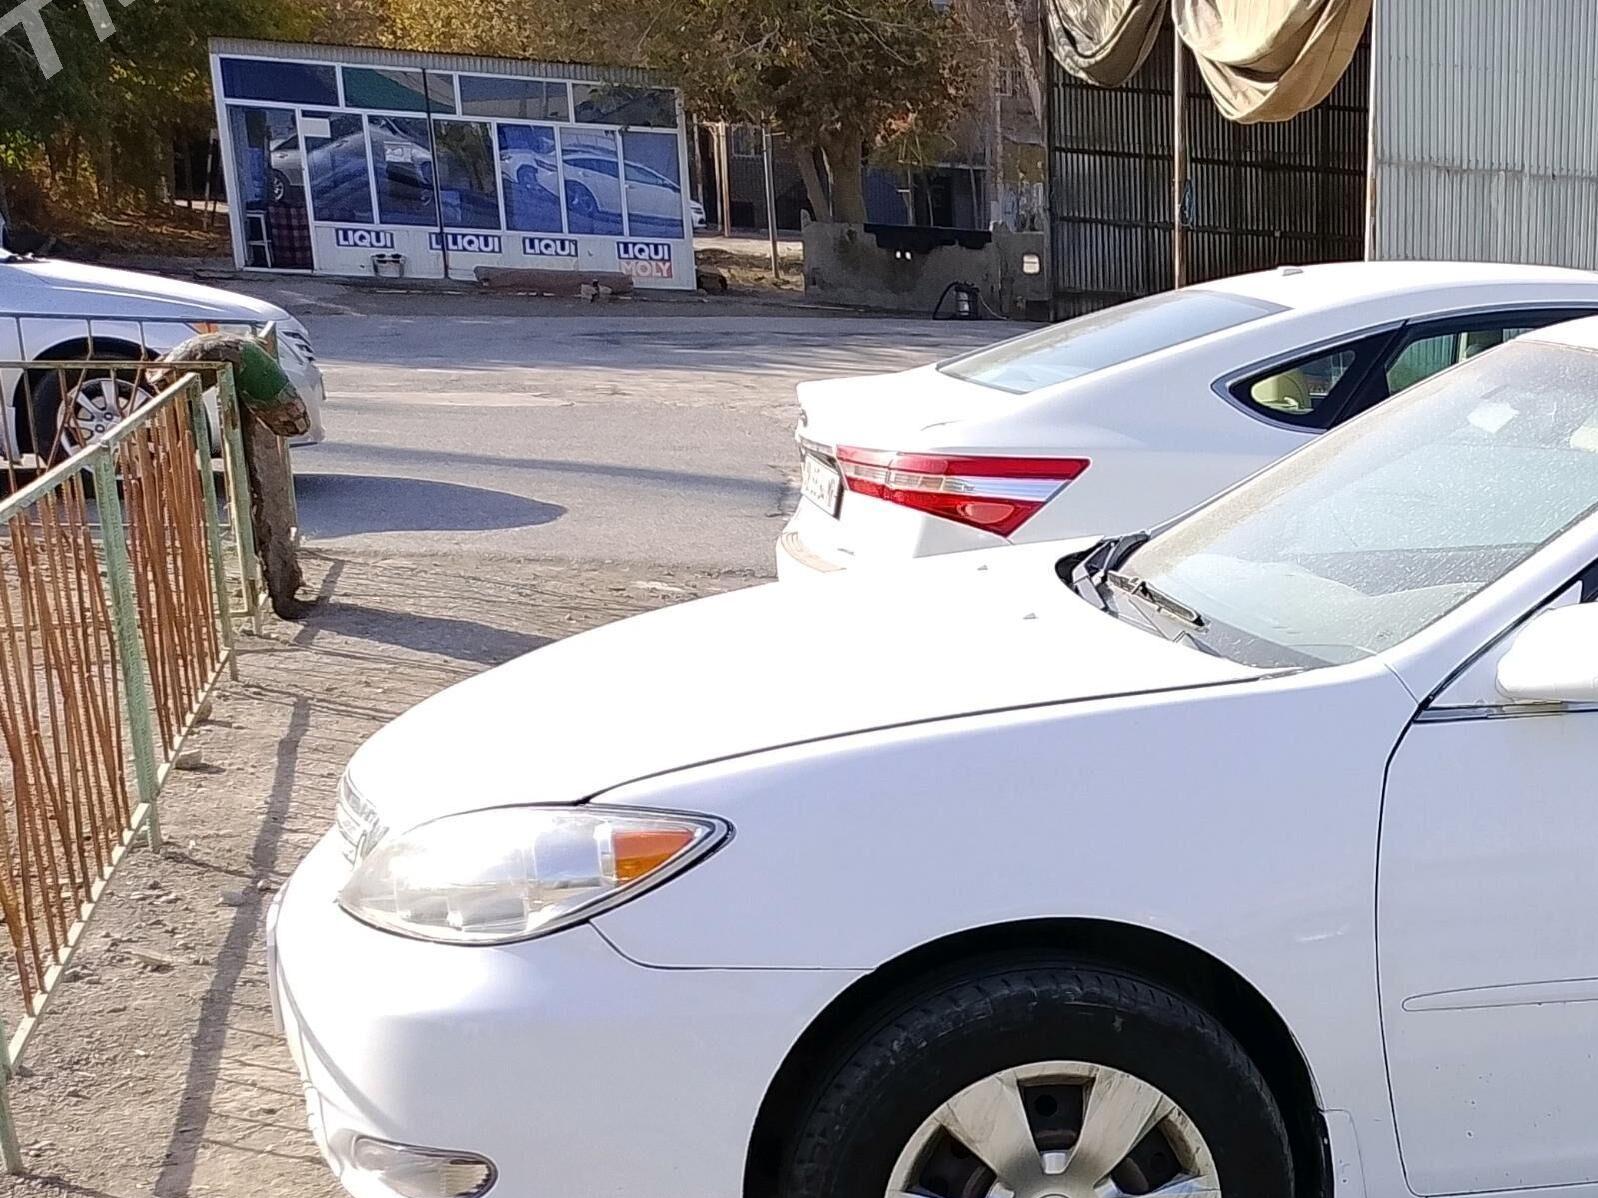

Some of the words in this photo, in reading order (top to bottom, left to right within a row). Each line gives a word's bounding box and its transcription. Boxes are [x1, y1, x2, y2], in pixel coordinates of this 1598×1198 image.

[337, 229, 392, 247] LIQUI
[447, 234, 499, 251] LIQUI
[524, 238, 577, 256] LIQUI
[618, 243, 670, 260] LIQUI
[620, 261, 671, 278] MOLY
